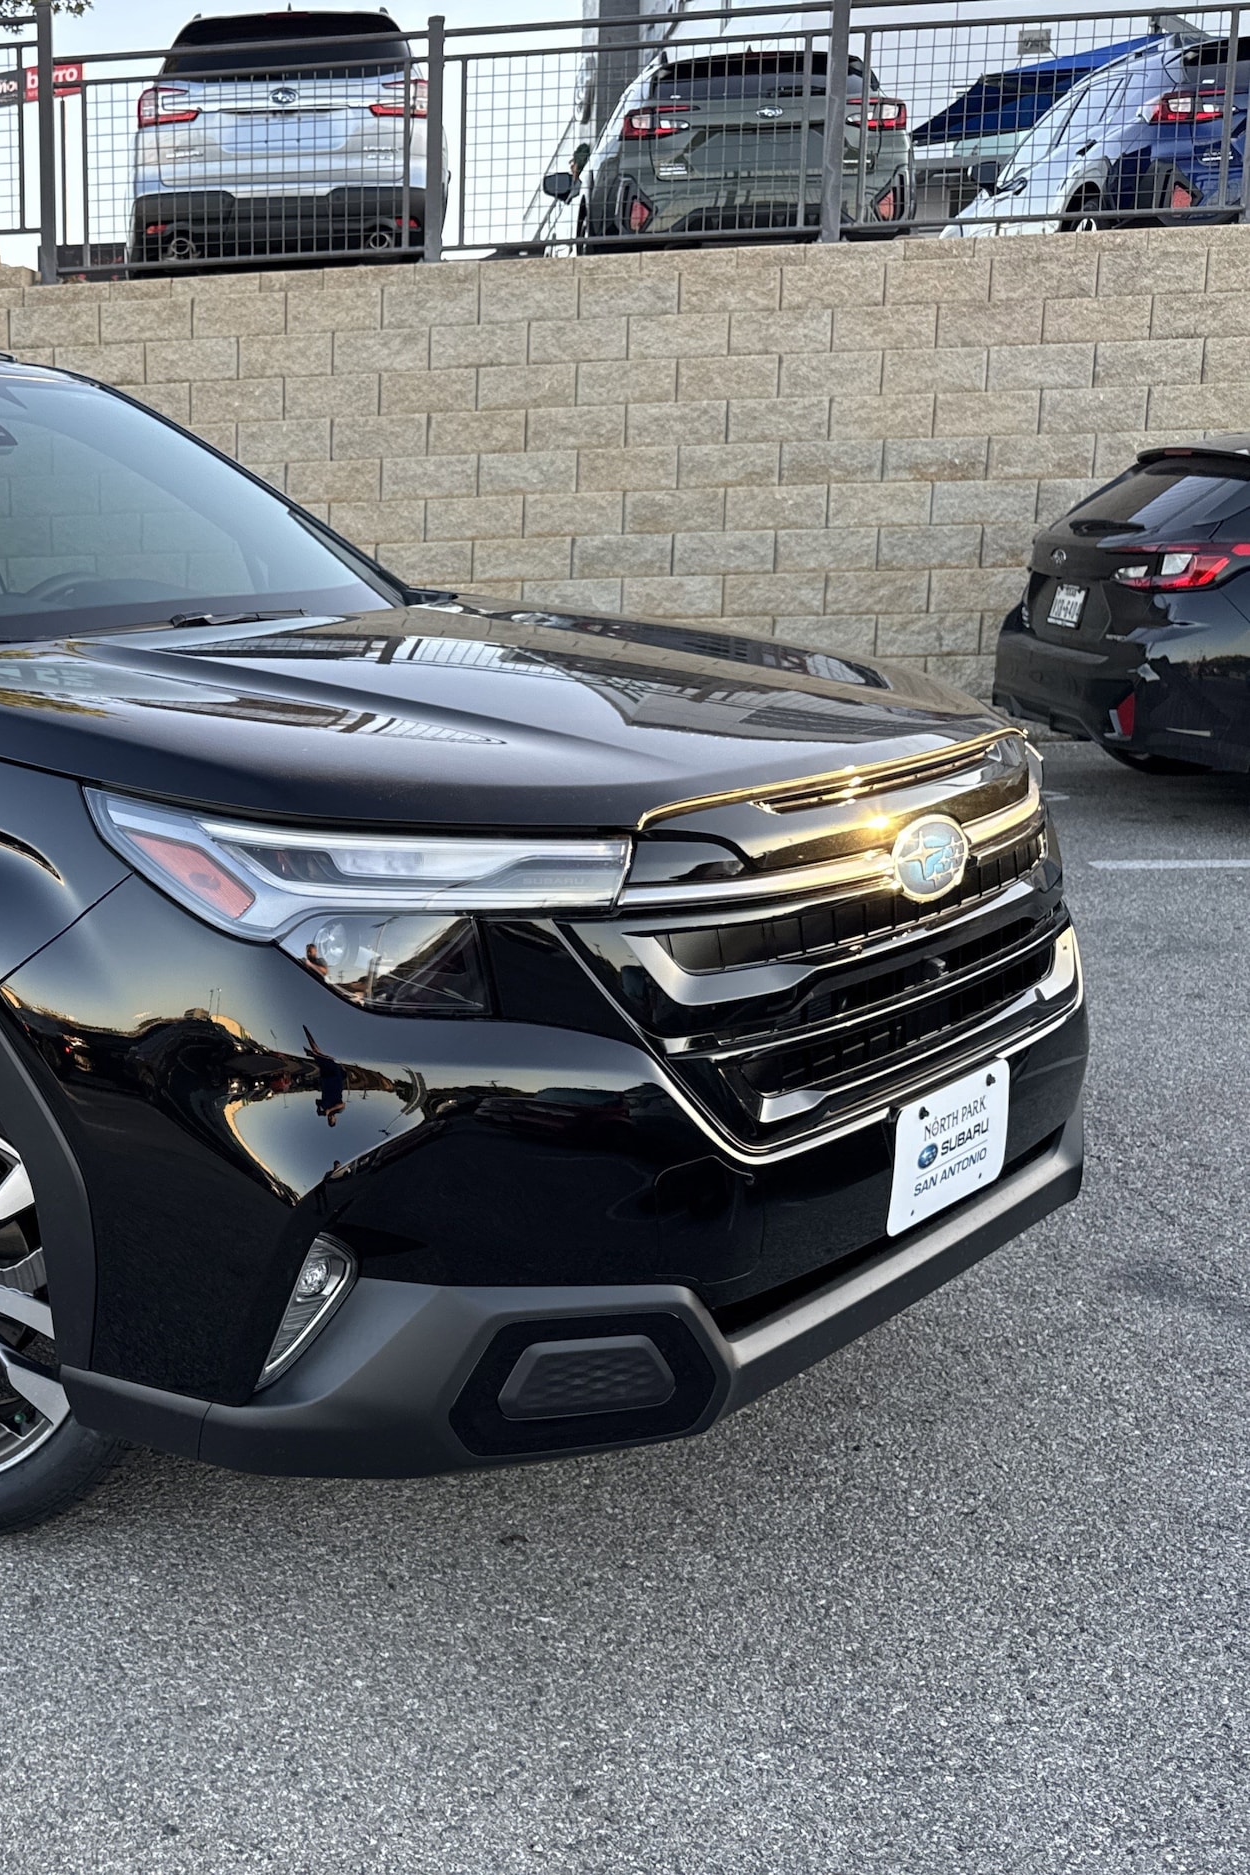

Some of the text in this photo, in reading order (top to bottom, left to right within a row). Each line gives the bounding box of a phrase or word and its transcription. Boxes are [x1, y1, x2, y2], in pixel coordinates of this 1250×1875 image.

[26, 67, 78, 89] brro
[924, 1095, 987, 1142] NORTH PARK
[940, 1117, 989, 1156] SUBARU
[914, 1147, 987, 1197] SAN ANTONIO
